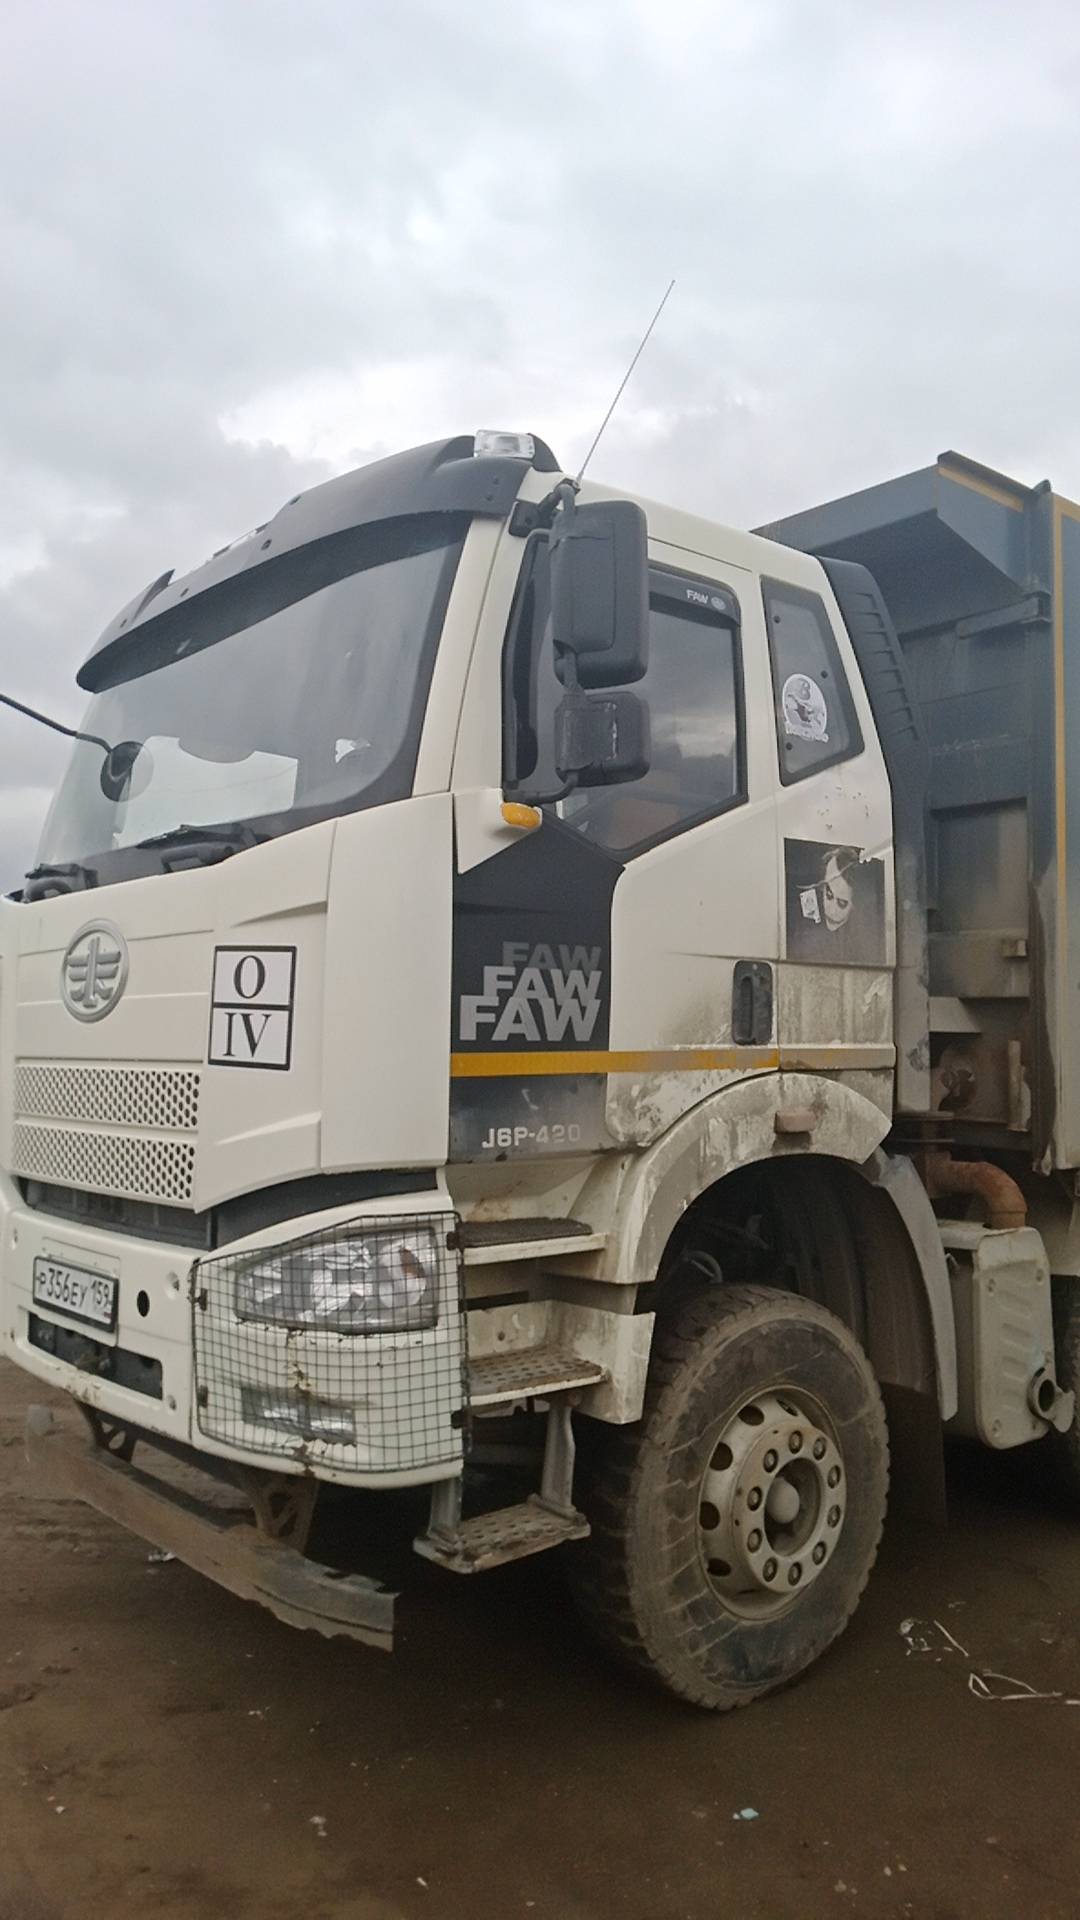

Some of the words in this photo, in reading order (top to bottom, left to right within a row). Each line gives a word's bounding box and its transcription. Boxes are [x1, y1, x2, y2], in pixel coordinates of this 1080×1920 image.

[686, 589, 709, 604] FAW
[503, 941, 602, 976] FAW
[483, 966, 602, 1006] FAW
[222, 1012, 272, 1058] IV
[459, 994, 601, 1042] FAW
[481, 1124, 581, 1148] J6P-420
